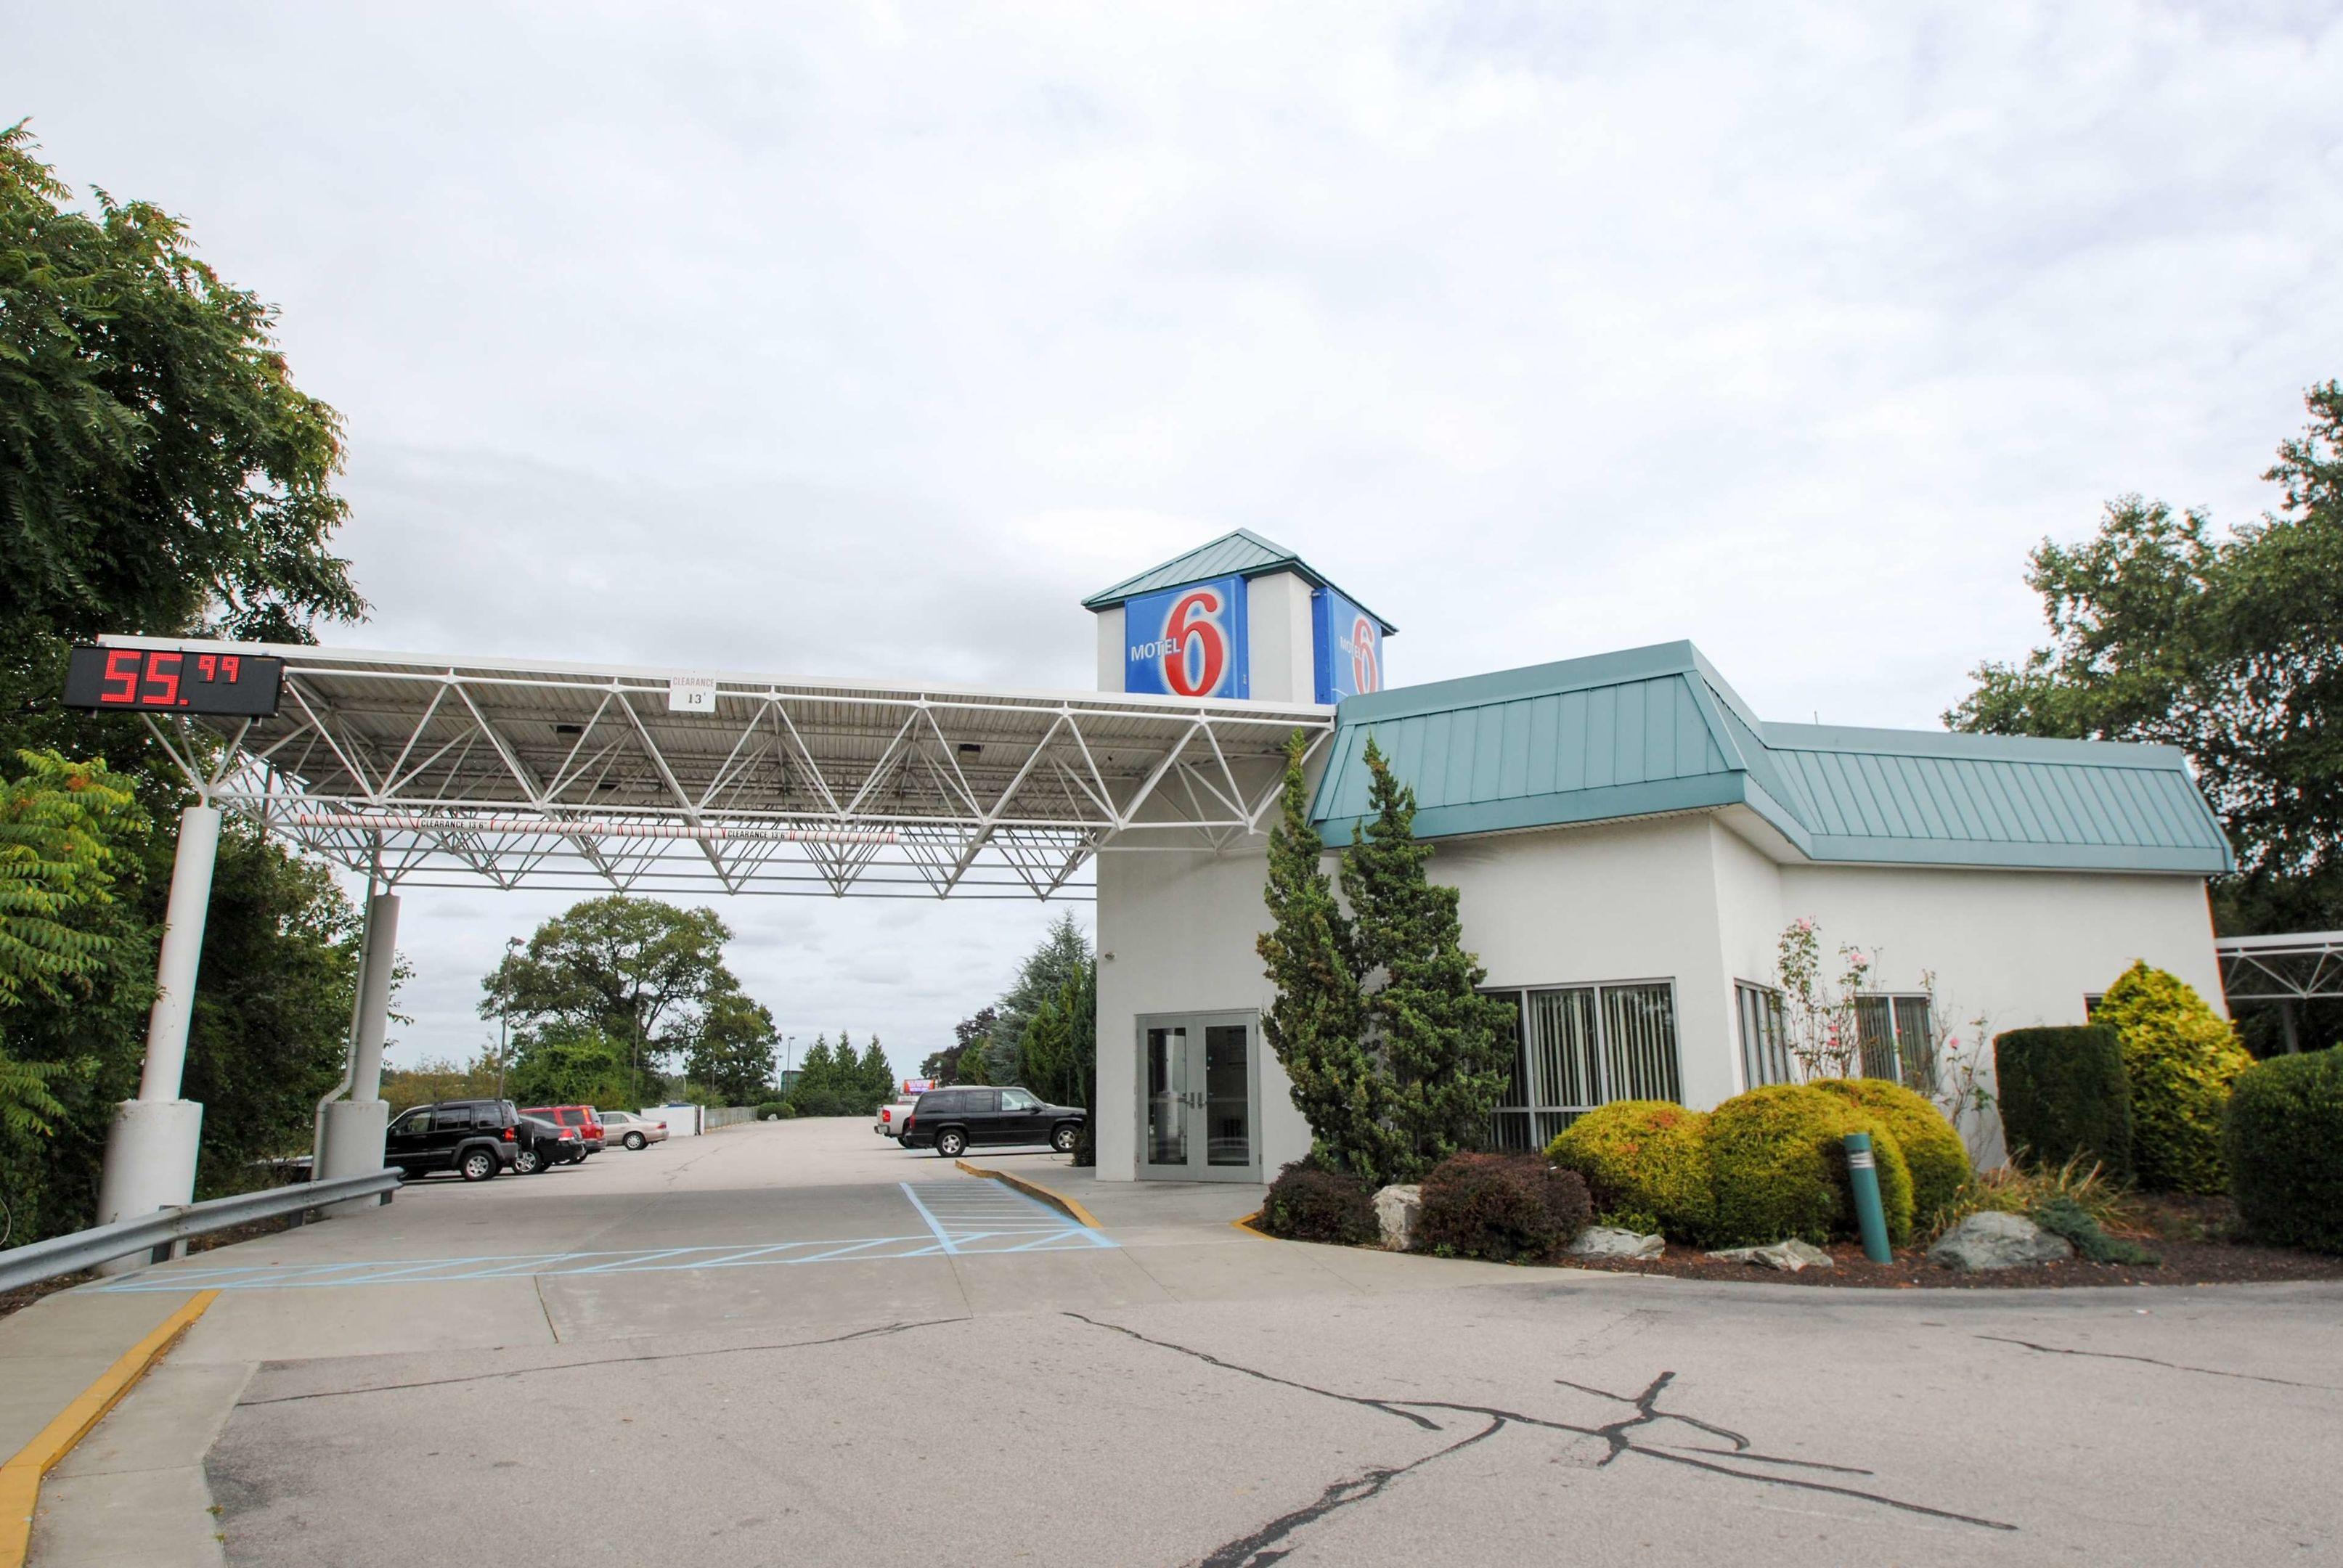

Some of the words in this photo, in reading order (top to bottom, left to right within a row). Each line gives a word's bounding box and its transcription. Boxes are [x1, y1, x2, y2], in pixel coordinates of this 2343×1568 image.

[1131, 637, 1181, 662] MOTEL
[1165, 592, 1223, 697] 6
[1353, 618, 1377, 695] 6
[673, 677, 714, 687] CLEARANCE
[421, 820, 465, 828] CLEARANCE
[728, 830, 767, 838] CLEARANCE
